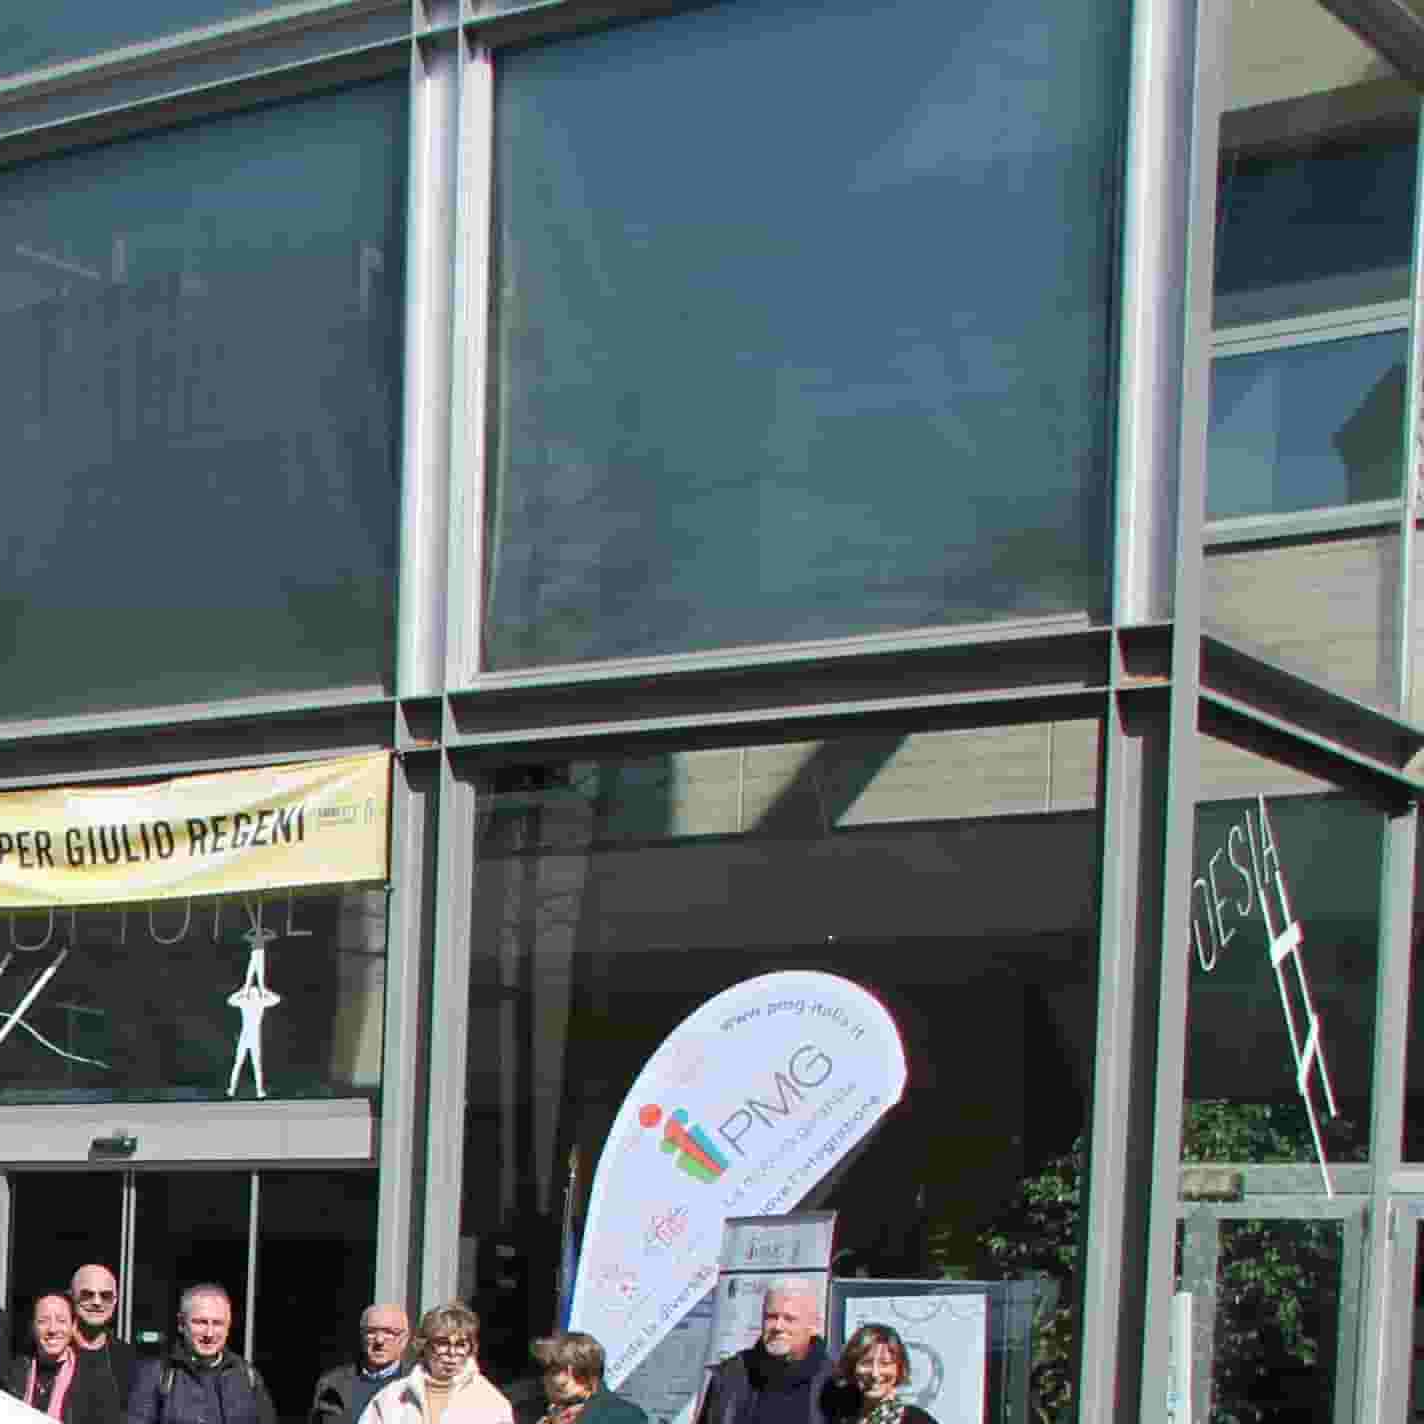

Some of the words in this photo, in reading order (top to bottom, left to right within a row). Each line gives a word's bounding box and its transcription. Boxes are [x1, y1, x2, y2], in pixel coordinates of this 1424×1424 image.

[64, 820, 175, 868] GIULIO
[187, 806, 305, 855] REGENI
[719, 1043, 833, 1157] PMG
